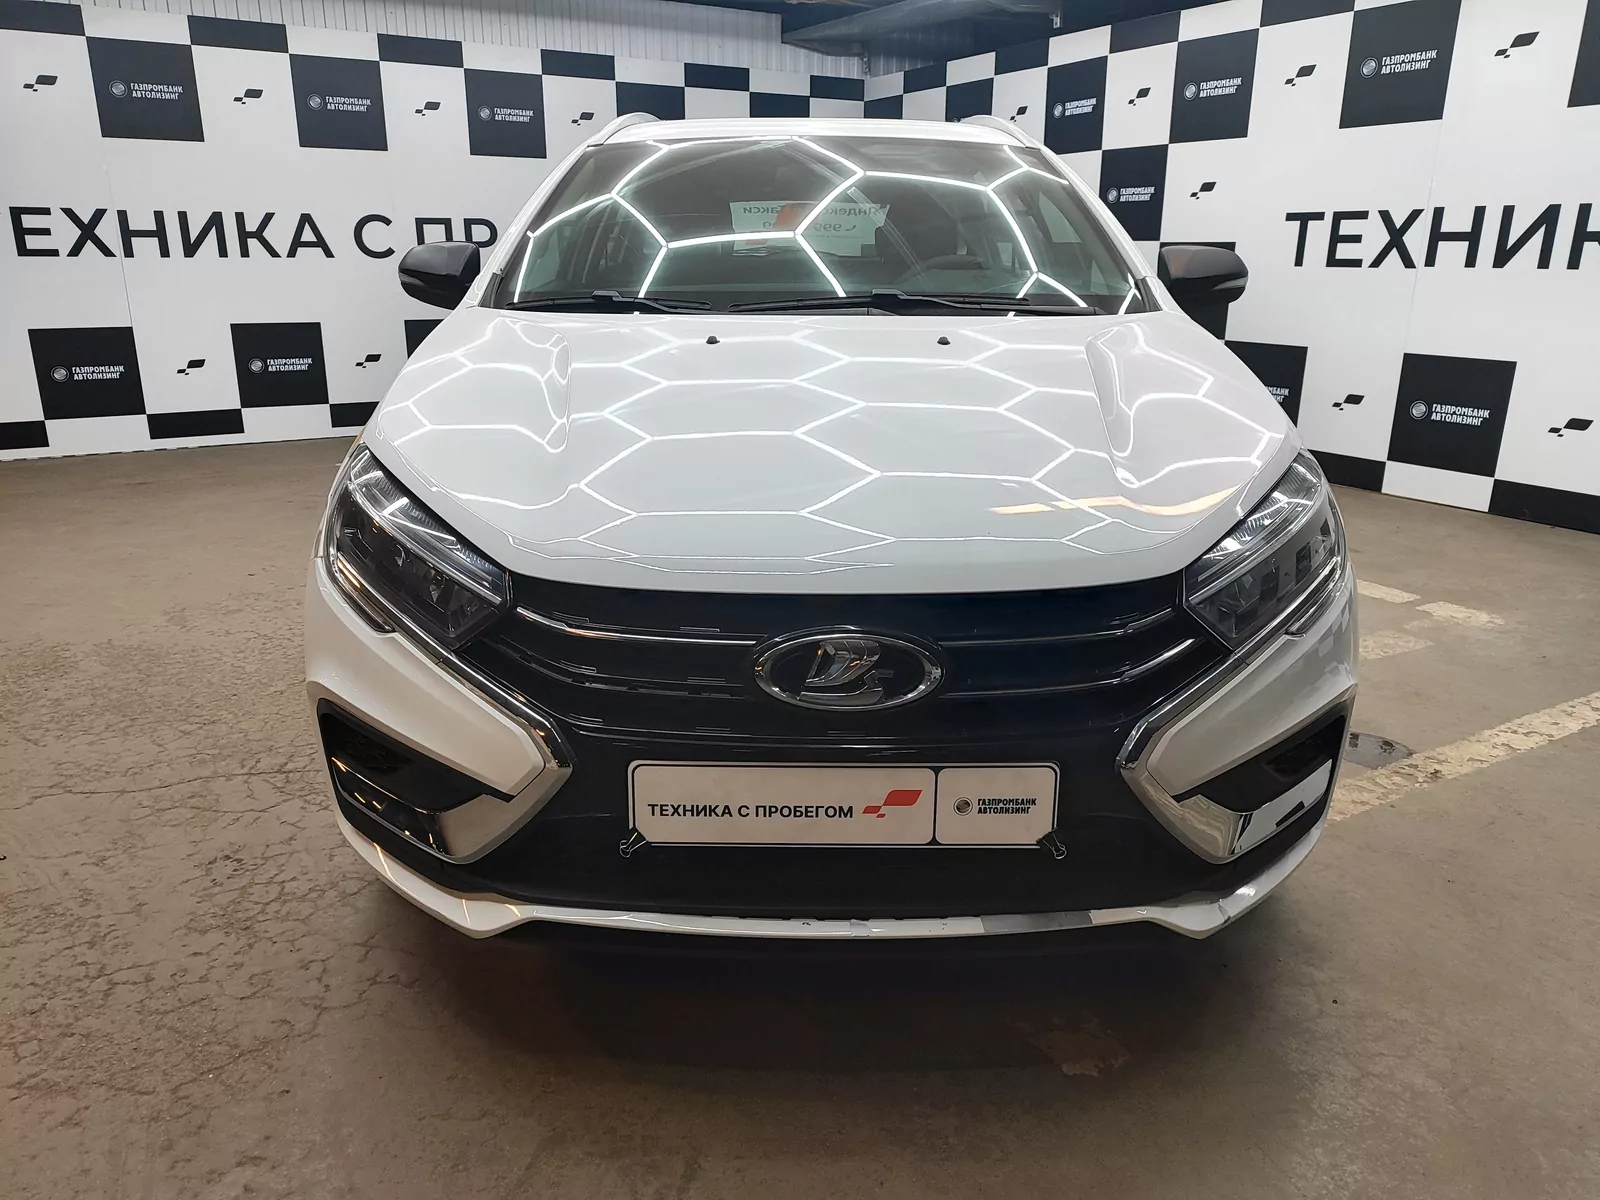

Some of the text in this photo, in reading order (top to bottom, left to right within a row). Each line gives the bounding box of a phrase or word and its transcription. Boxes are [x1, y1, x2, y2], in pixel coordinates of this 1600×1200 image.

[1382, 50, 1438, 65] ГАЗПРОМБАНК
[1381, 60, 1431, 75] АВТОЛИЗИНГ
[1200, 77, 1242, 89] ГАЗПРОМБАНК
[130, 83, 183, 93] ГАЗПРОМБАНК
[1199, 86, 1237, 97] АВТОЛИЗИНГ
[132, 91, 179, 100] АВТОЛИЗИНГ
[325, 96, 371, 105] ГАЗПРОМБАНК
[326, 104, 368, 112] АВТОЛИЗИНГ
[494, 108, 534, 117] ГАЗПРОМБАНК
[495, 115, 530, 123] АВТОЛИЗИНГ
[0, 206, 335, 259] ЕХНИКА
[353, 213, 396, 259] С
[266, 358, 313, 366] ГАЗПРОМБАНК
[72, 365, 125, 374] ГАЗПРОМБАНК
[268, 364, 308, 372] АВТОЛИЗИНГ
[73, 372, 121, 381] АВТОЛИЗИНГ
[1432, 403, 1490, 418] ГАЗПРОМБАНК
[1431, 412, 1483, 426] АВТОЛИЗИНГ
[978, 798, 1037, 806] ГАЗПРОМБАНК
[647, 804, 854, 819] ТЕХНИКА С ПРОБЕГОМ
[977, 806, 1031, 815] АВТОЛИЗИНГ
